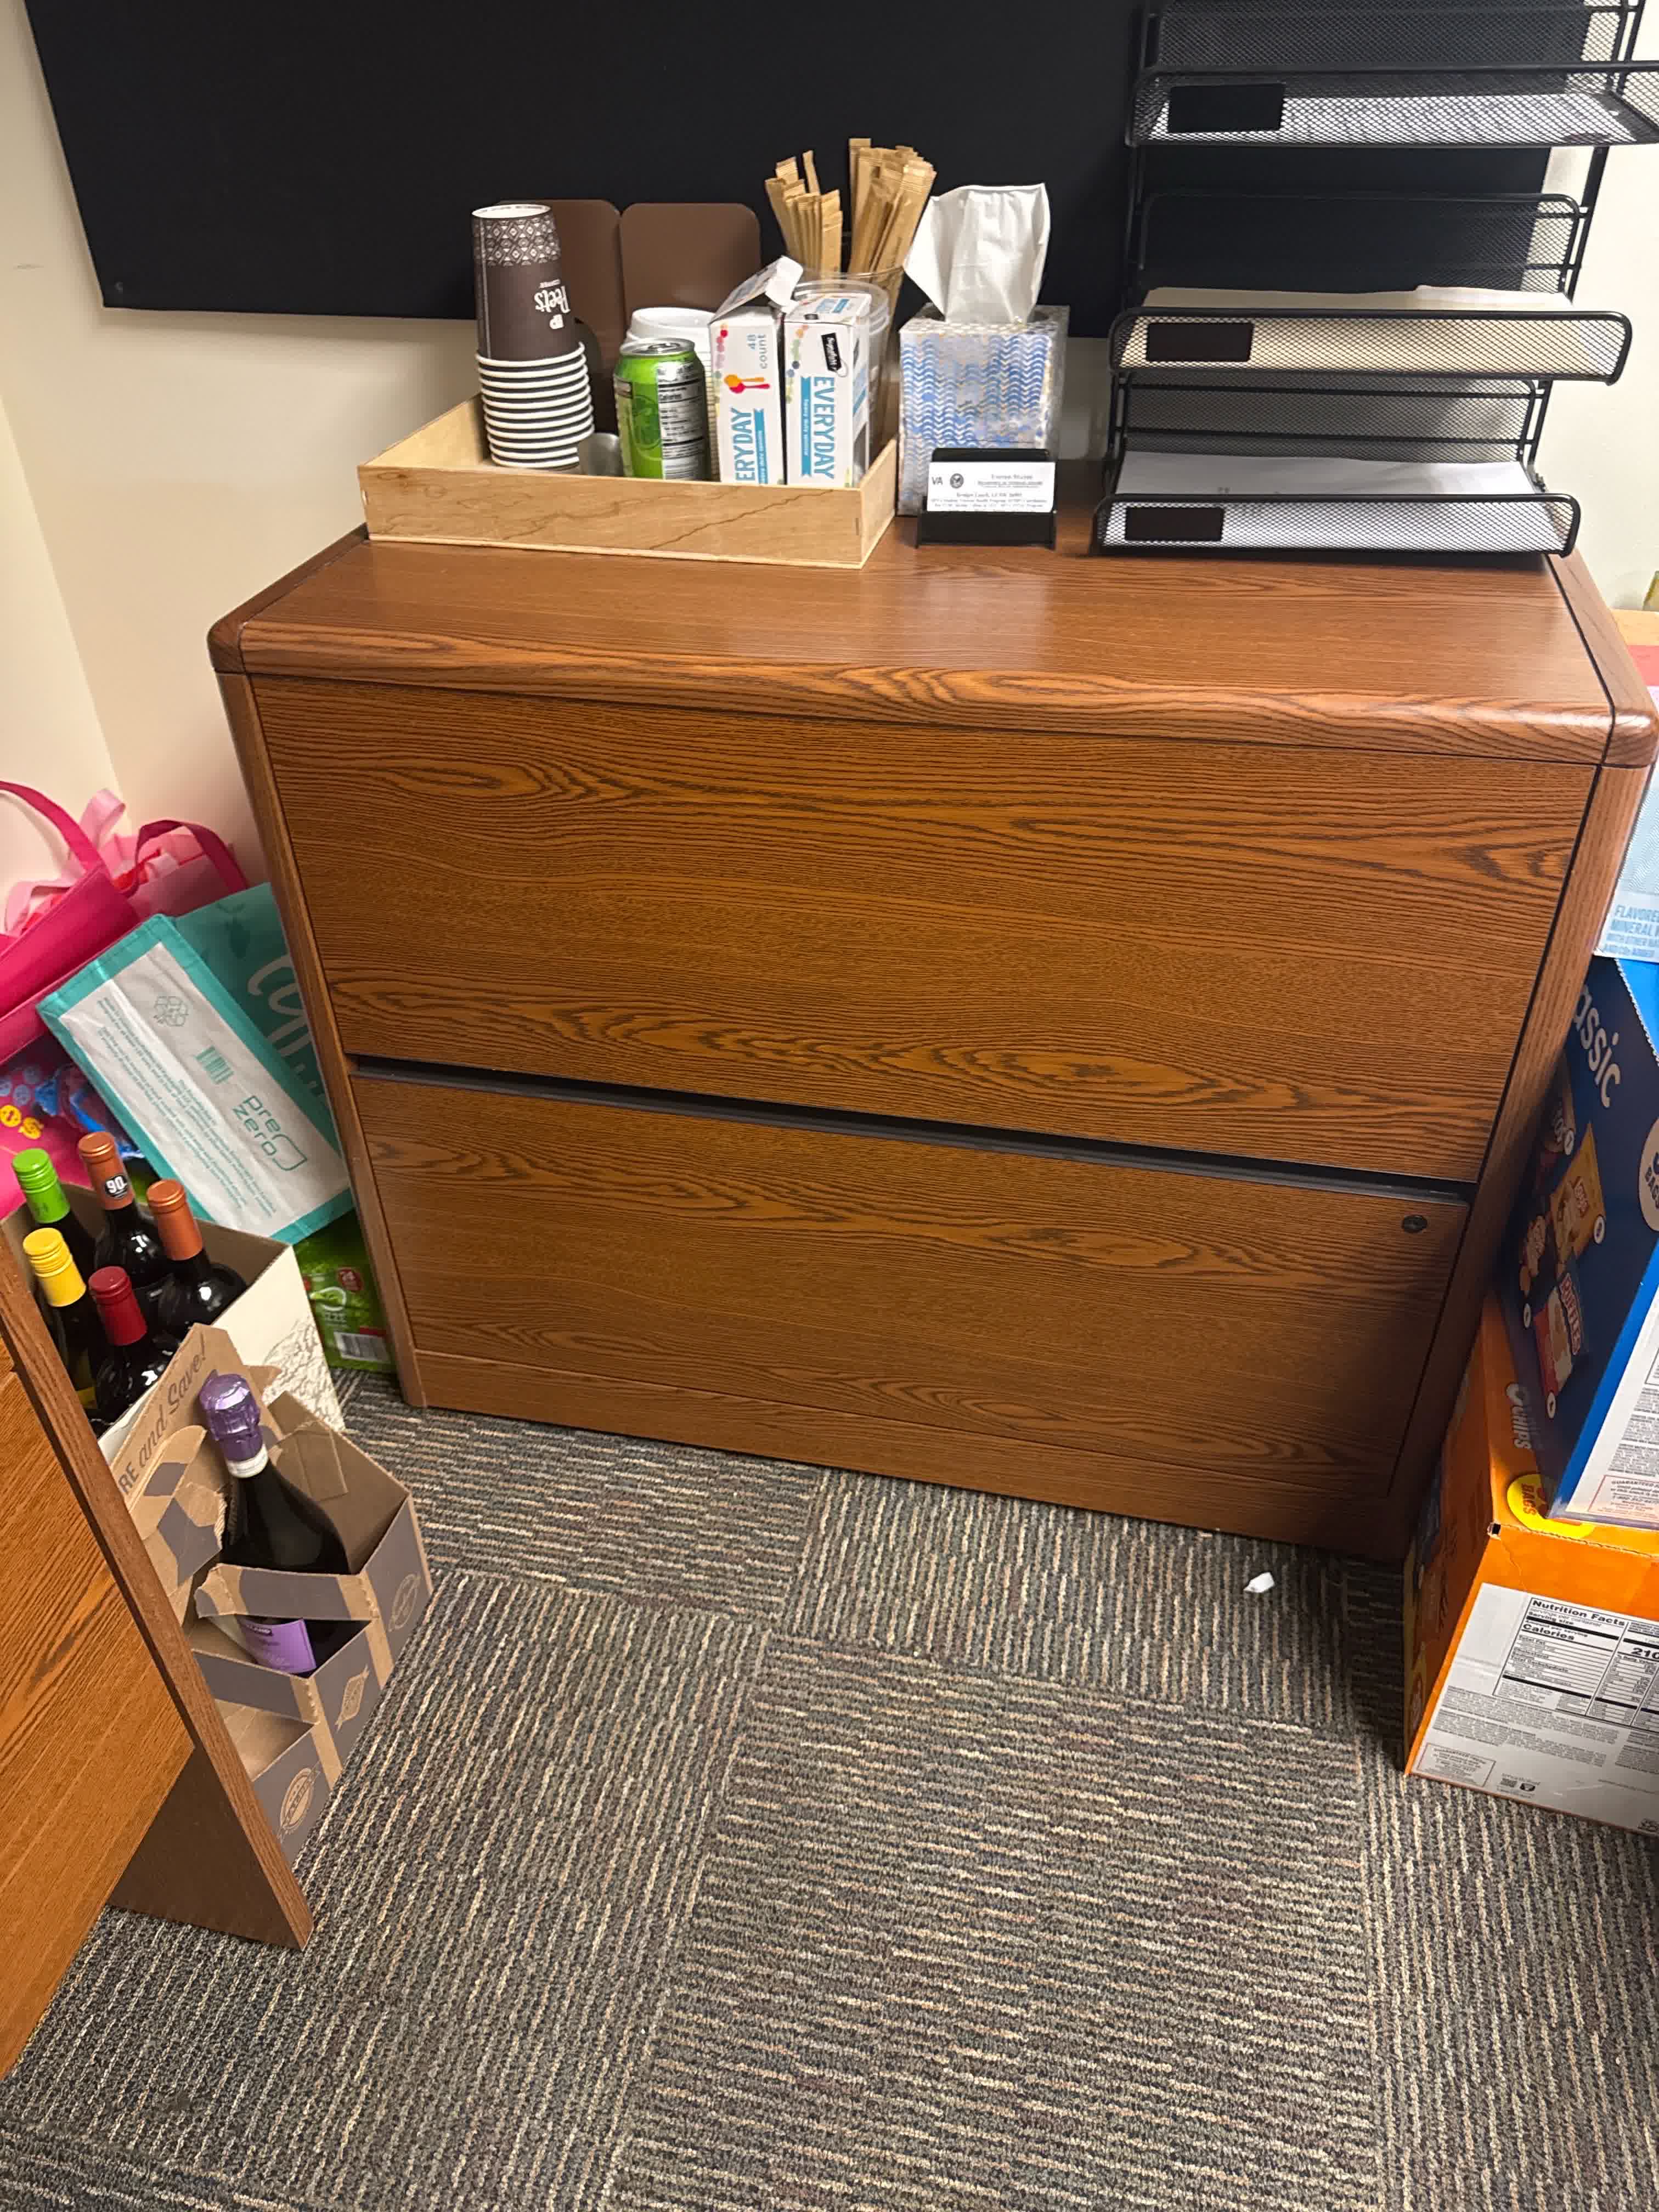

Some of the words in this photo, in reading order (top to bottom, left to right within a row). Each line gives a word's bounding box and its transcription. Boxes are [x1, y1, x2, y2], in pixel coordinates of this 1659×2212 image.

[534, 285, 571, 313] Peet's
[758, 334, 768, 369] count
[814, 377, 835, 479] EVERYDAY
[932, 477, 943, 486] VA
[243, 1095, 281, 1133] pre
[233, 1104, 276, 1156] zero
[139, 1404, 166, 1468] and
[167, 1332, 206, 1415] Save!
[1522, 1483, 1537, 1516] BAGS
[1528, 1612, 1556, 1622] Serving
[1532, 1600, 1588, 1618] Nutrition
[1590, 1613, 1626, 1626] Facts
[1522, 1624, 1575, 1641] Calories
[1631, 1647, 1659, 1660] 210
